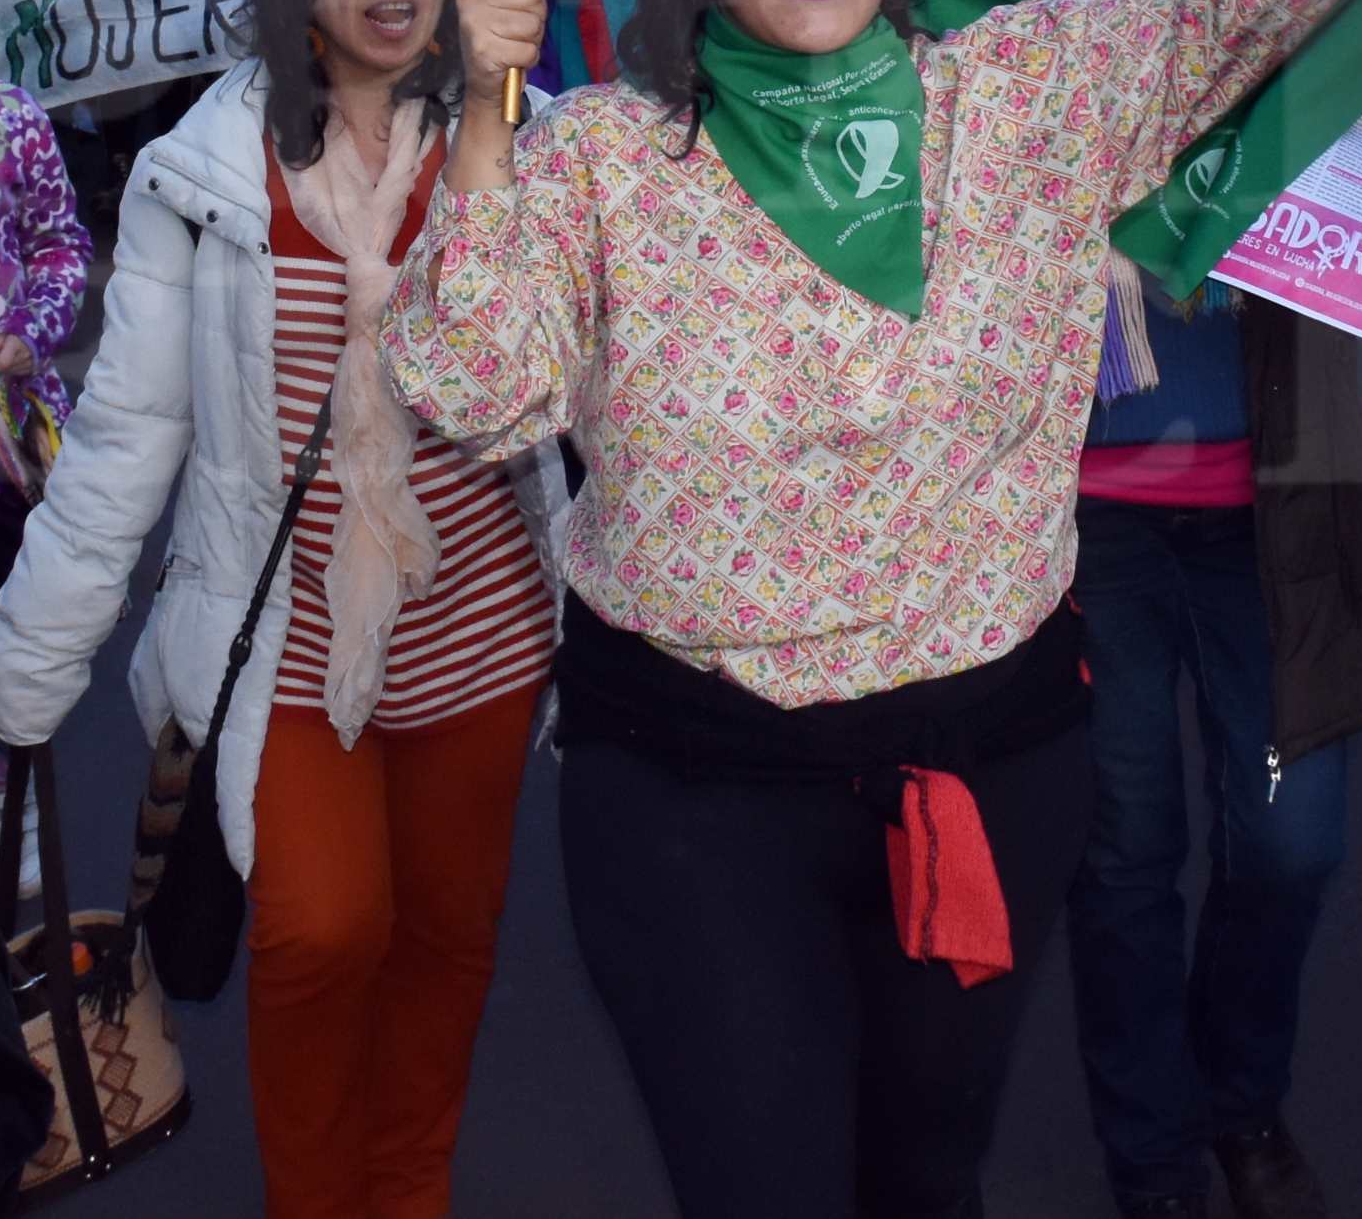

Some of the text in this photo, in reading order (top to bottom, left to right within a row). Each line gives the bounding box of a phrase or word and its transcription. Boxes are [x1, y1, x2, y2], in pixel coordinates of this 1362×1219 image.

[752, 84, 801, 98] Campaña
[770, 95, 805, 107] borto
[1266, 243, 1279, 257] EN
